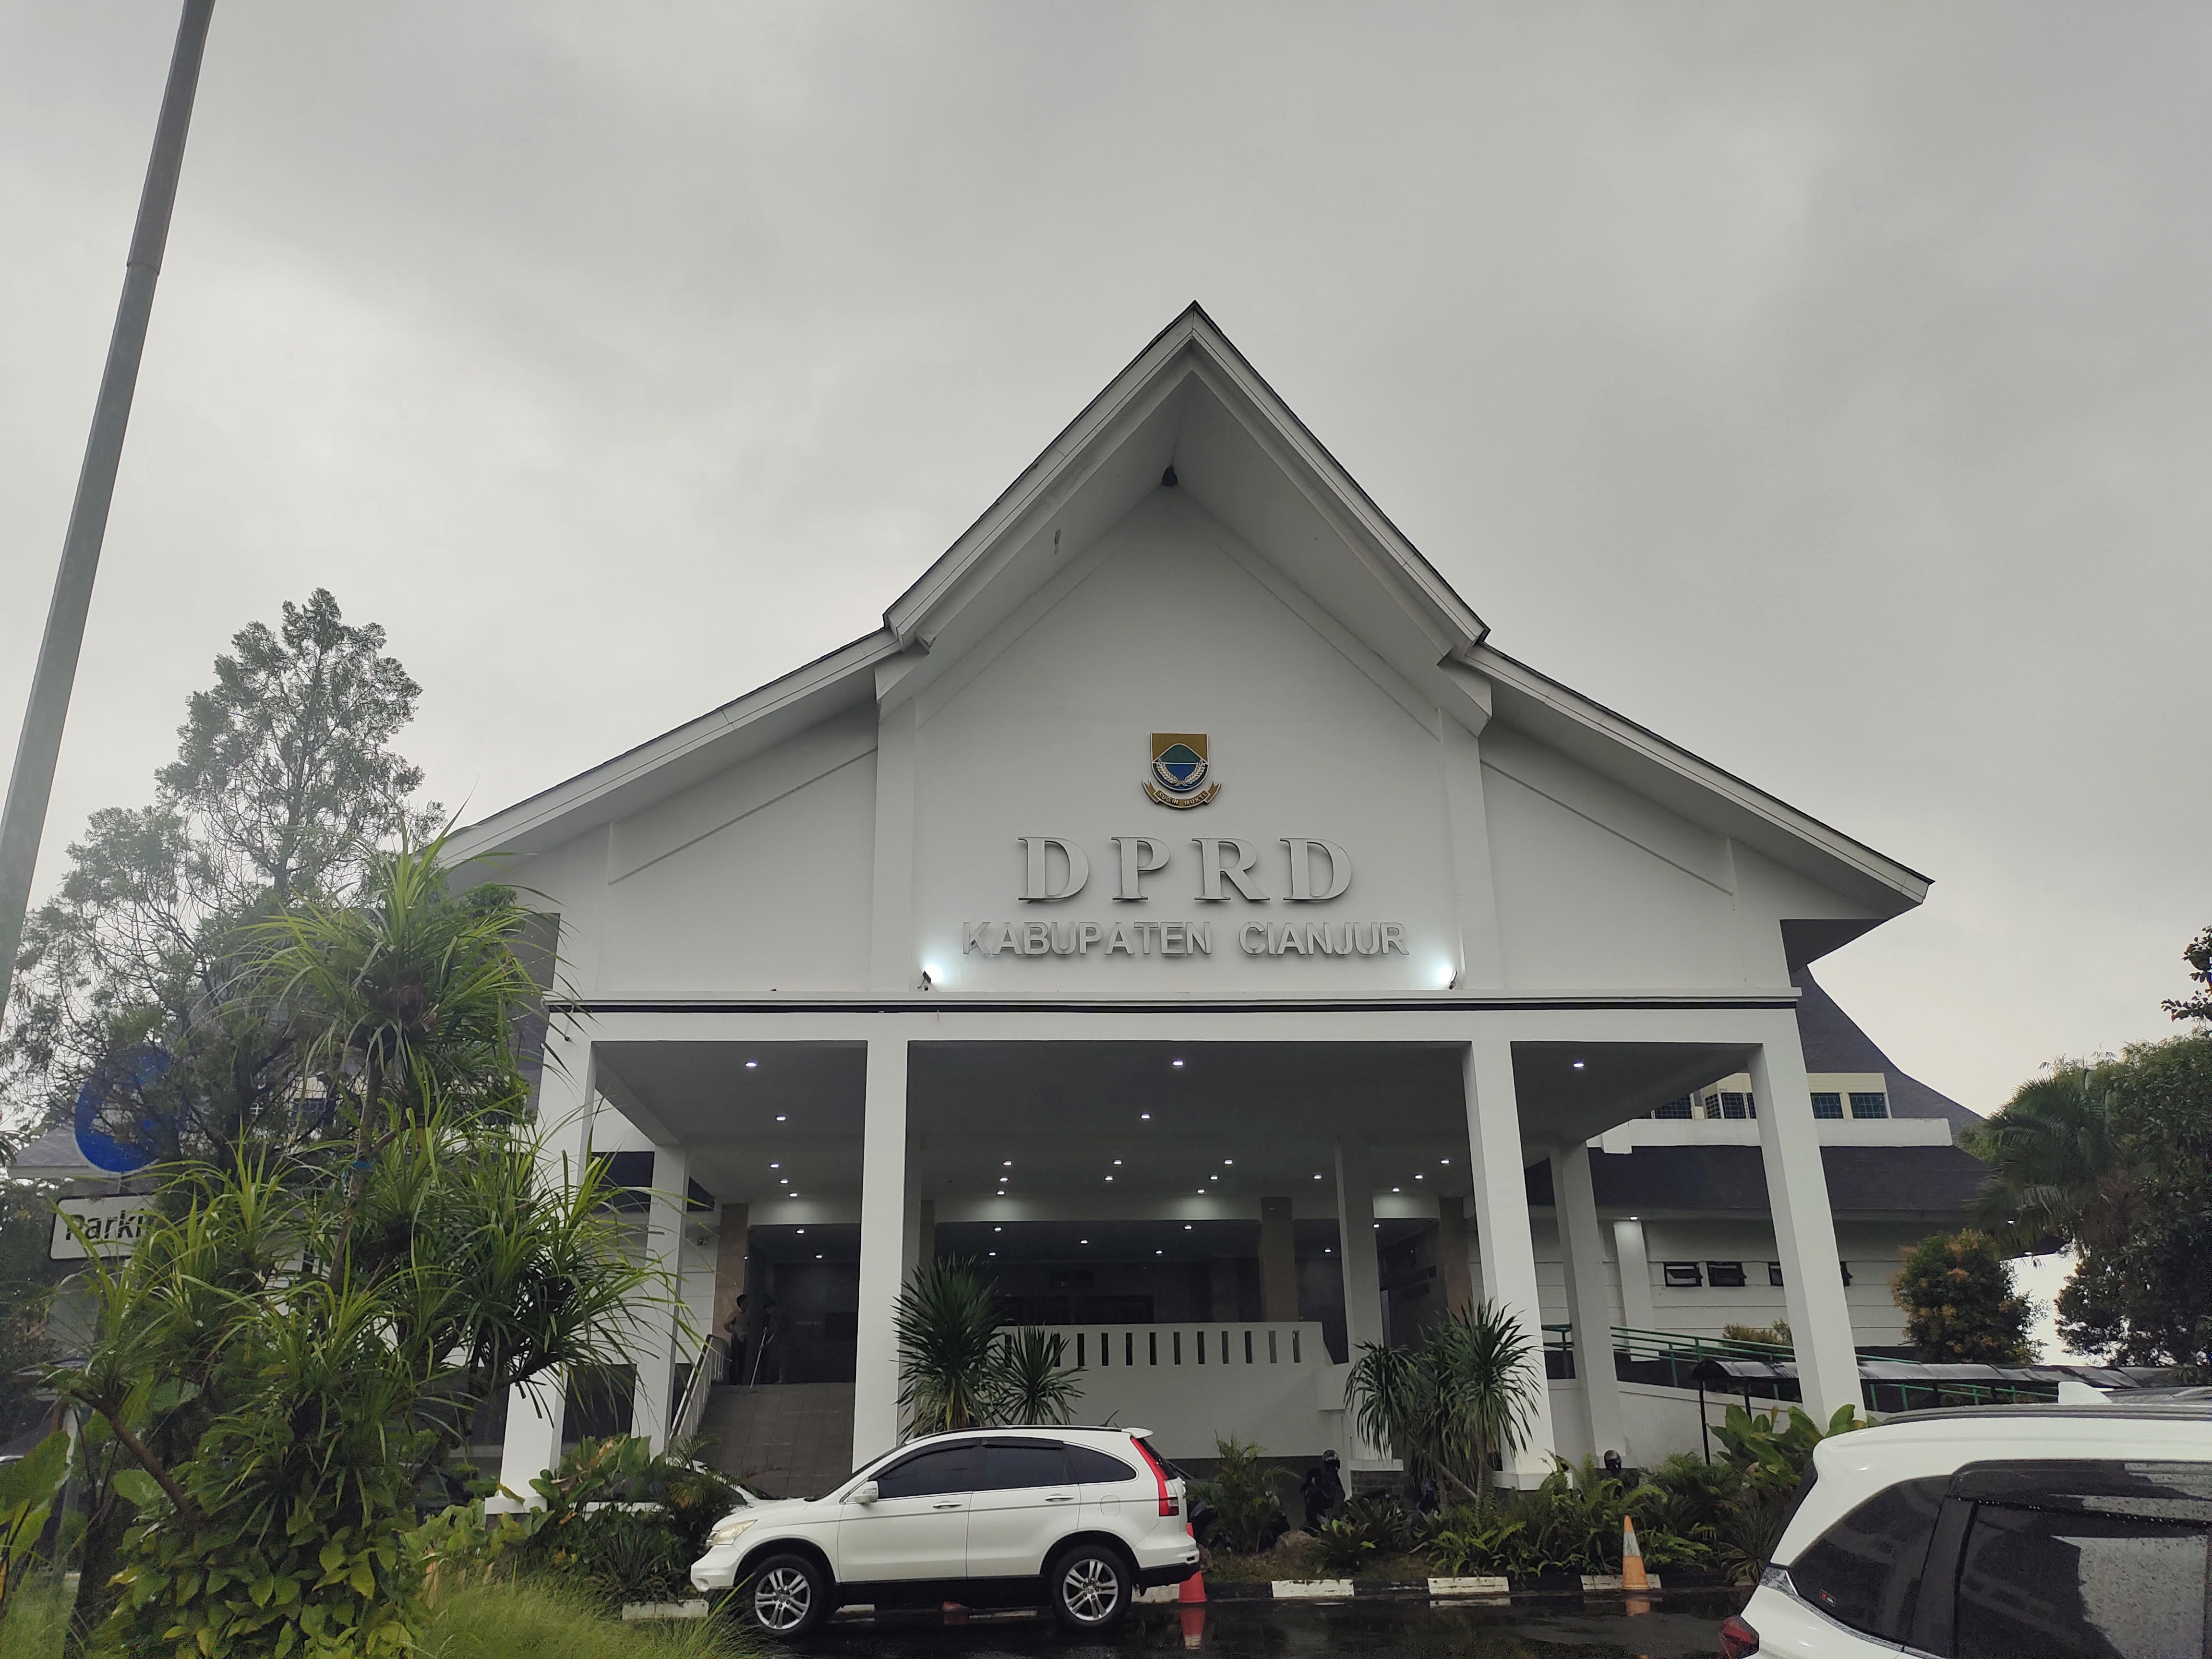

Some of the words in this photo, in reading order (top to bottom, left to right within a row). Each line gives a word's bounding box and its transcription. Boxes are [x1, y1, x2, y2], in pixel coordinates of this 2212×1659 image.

[1158, 792, 1179, 805] SUGIH
[1184, 792, 1207, 805] MUKTI
[1017, 836, 1352, 901] DPRD
[962, 921, 1212, 955] KABUPATEN
[1238, 921, 1409, 955] CIANJUR
[66, 1208, 145, 1240] Parki
